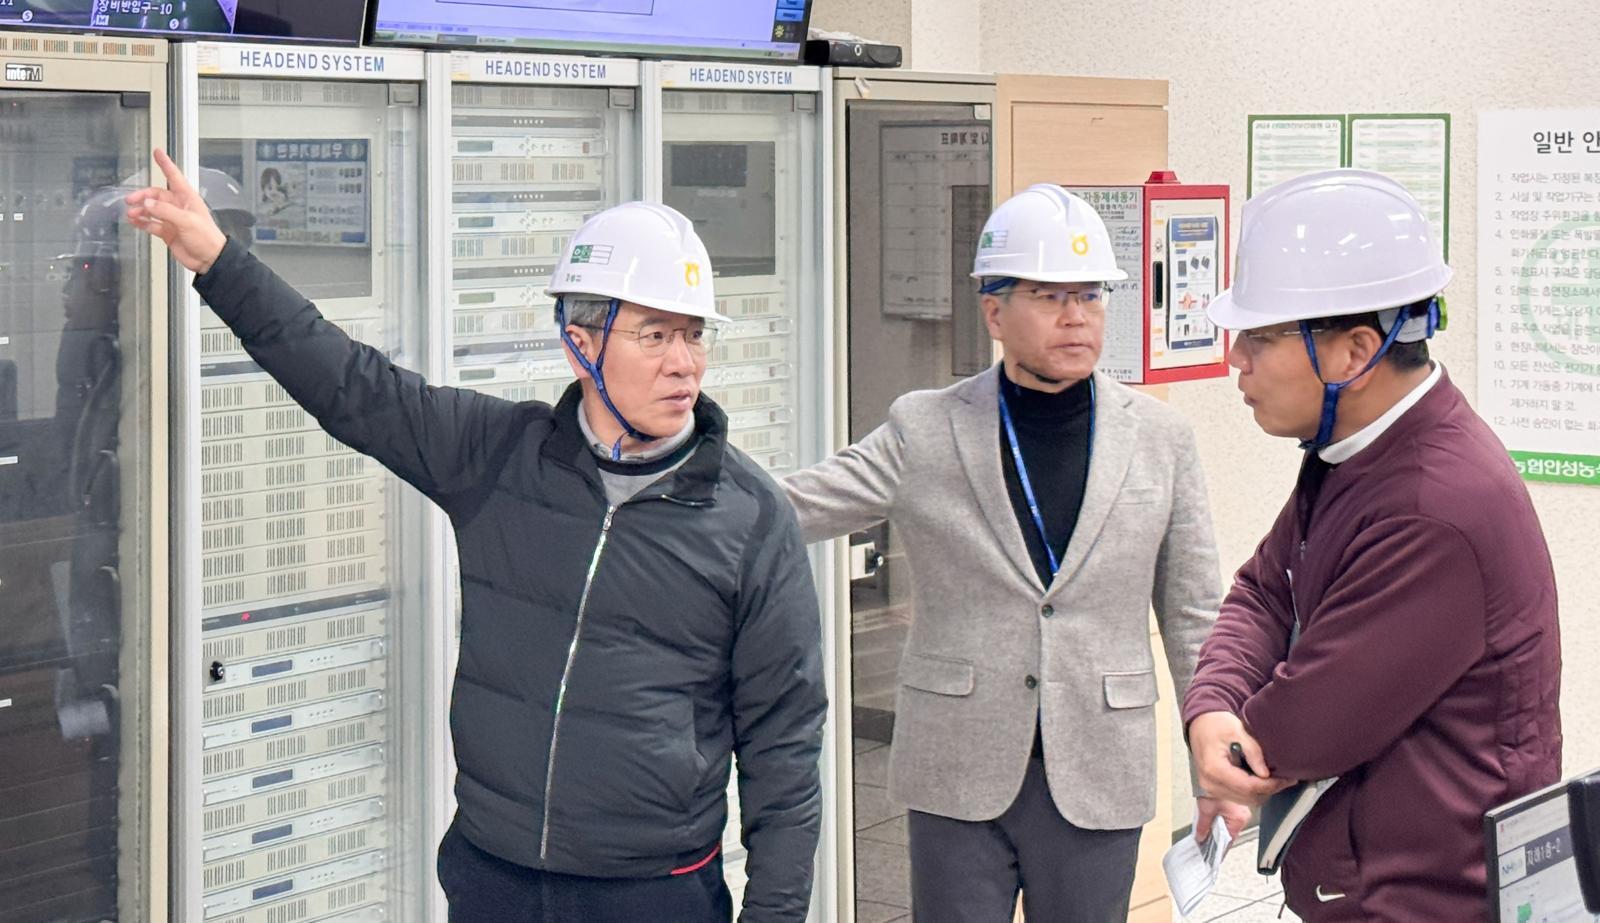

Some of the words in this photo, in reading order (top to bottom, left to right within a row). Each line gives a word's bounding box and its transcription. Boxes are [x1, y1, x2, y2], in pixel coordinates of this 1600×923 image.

[240, 51, 319, 70] HEADEND
[322, 54, 385, 72] SYSTEM
[485, 60, 552, 77] HEADEND
[553, 62, 607, 79] SYSTEM
[689, 67, 745, 84] HEADEND
[747, 70, 793, 85] SYSTEM
[1534, 131, 1574, 154] 일반
[1551, 173, 1581, 184] 지정된
[1510, 304, 1529, 315] 모든
[1510, 360, 1529, 372] 모든
[1510, 379, 1529, 391] 기계
[1509, 398, 1548, 410] 제거하지
[1510, 416, 1529, 428] 사전
